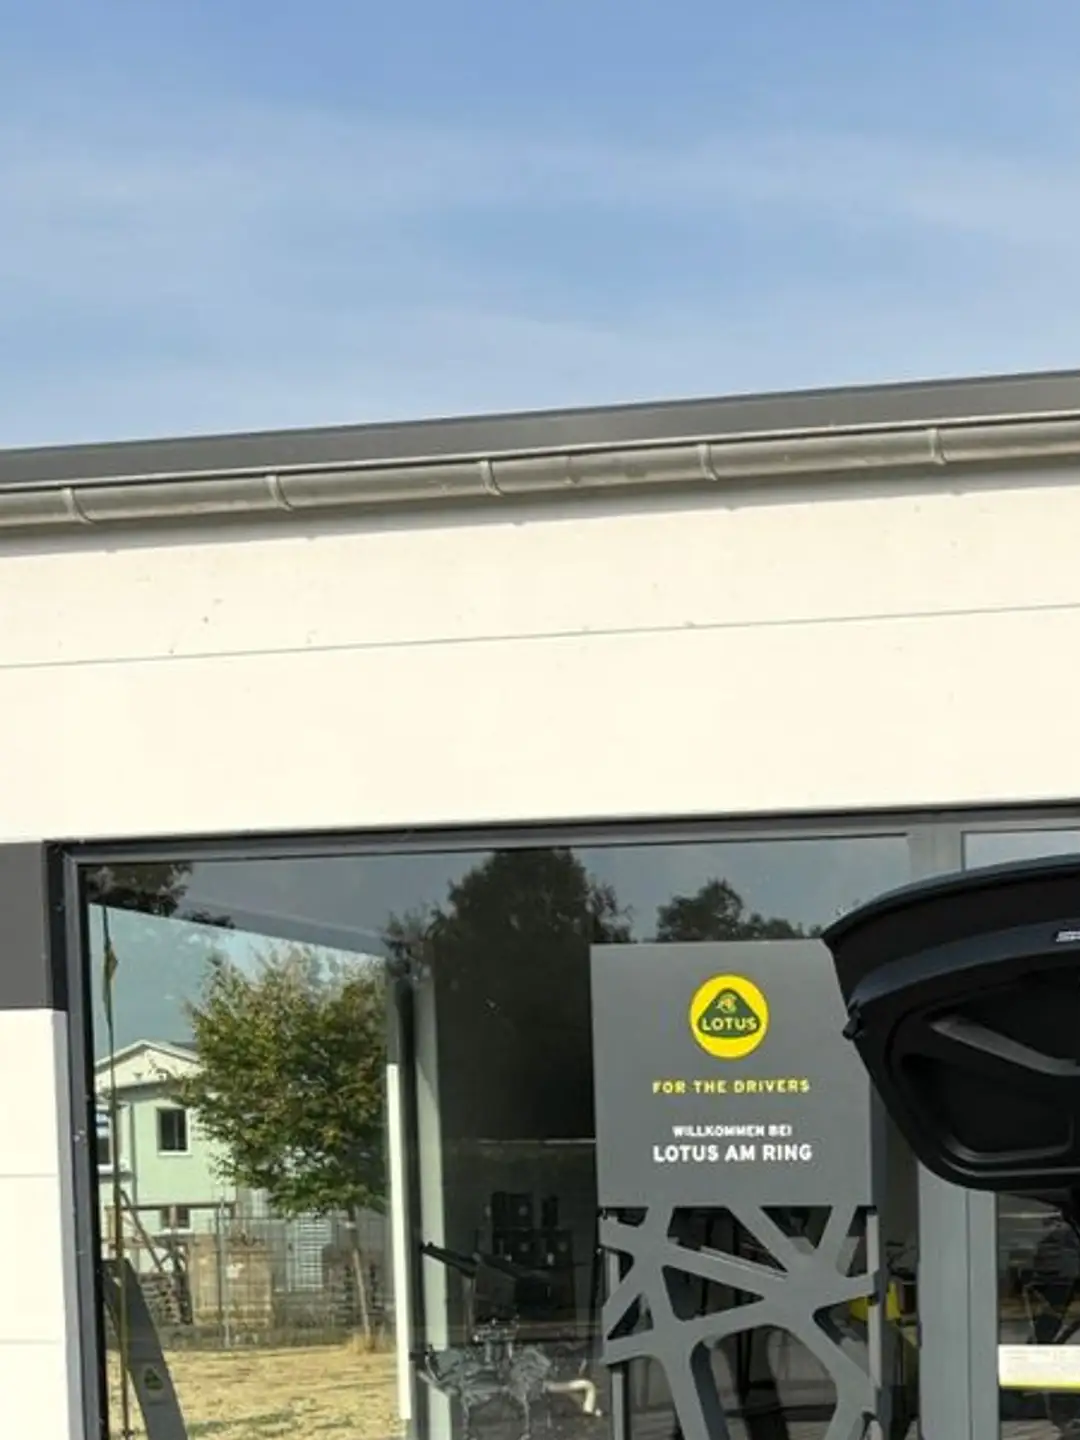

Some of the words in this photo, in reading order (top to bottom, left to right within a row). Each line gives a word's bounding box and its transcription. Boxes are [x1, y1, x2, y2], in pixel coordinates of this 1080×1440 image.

[701, 1016, 757, 1032] LOTUS
[652, 1080, 686, 1093] FOR
[692, 1079, 726, 1093] THE
[734, 1078, 810, 1092] DRIVERS
[672, 1124, 764, 1137] WILLKOMMEN
[769, 1124, 792, 1136] BEI
[653, 1146, 718, 1162] LOTUS
[724, 1145, 755, 1161] AM
[763, 1143, 812, 1161] RING
